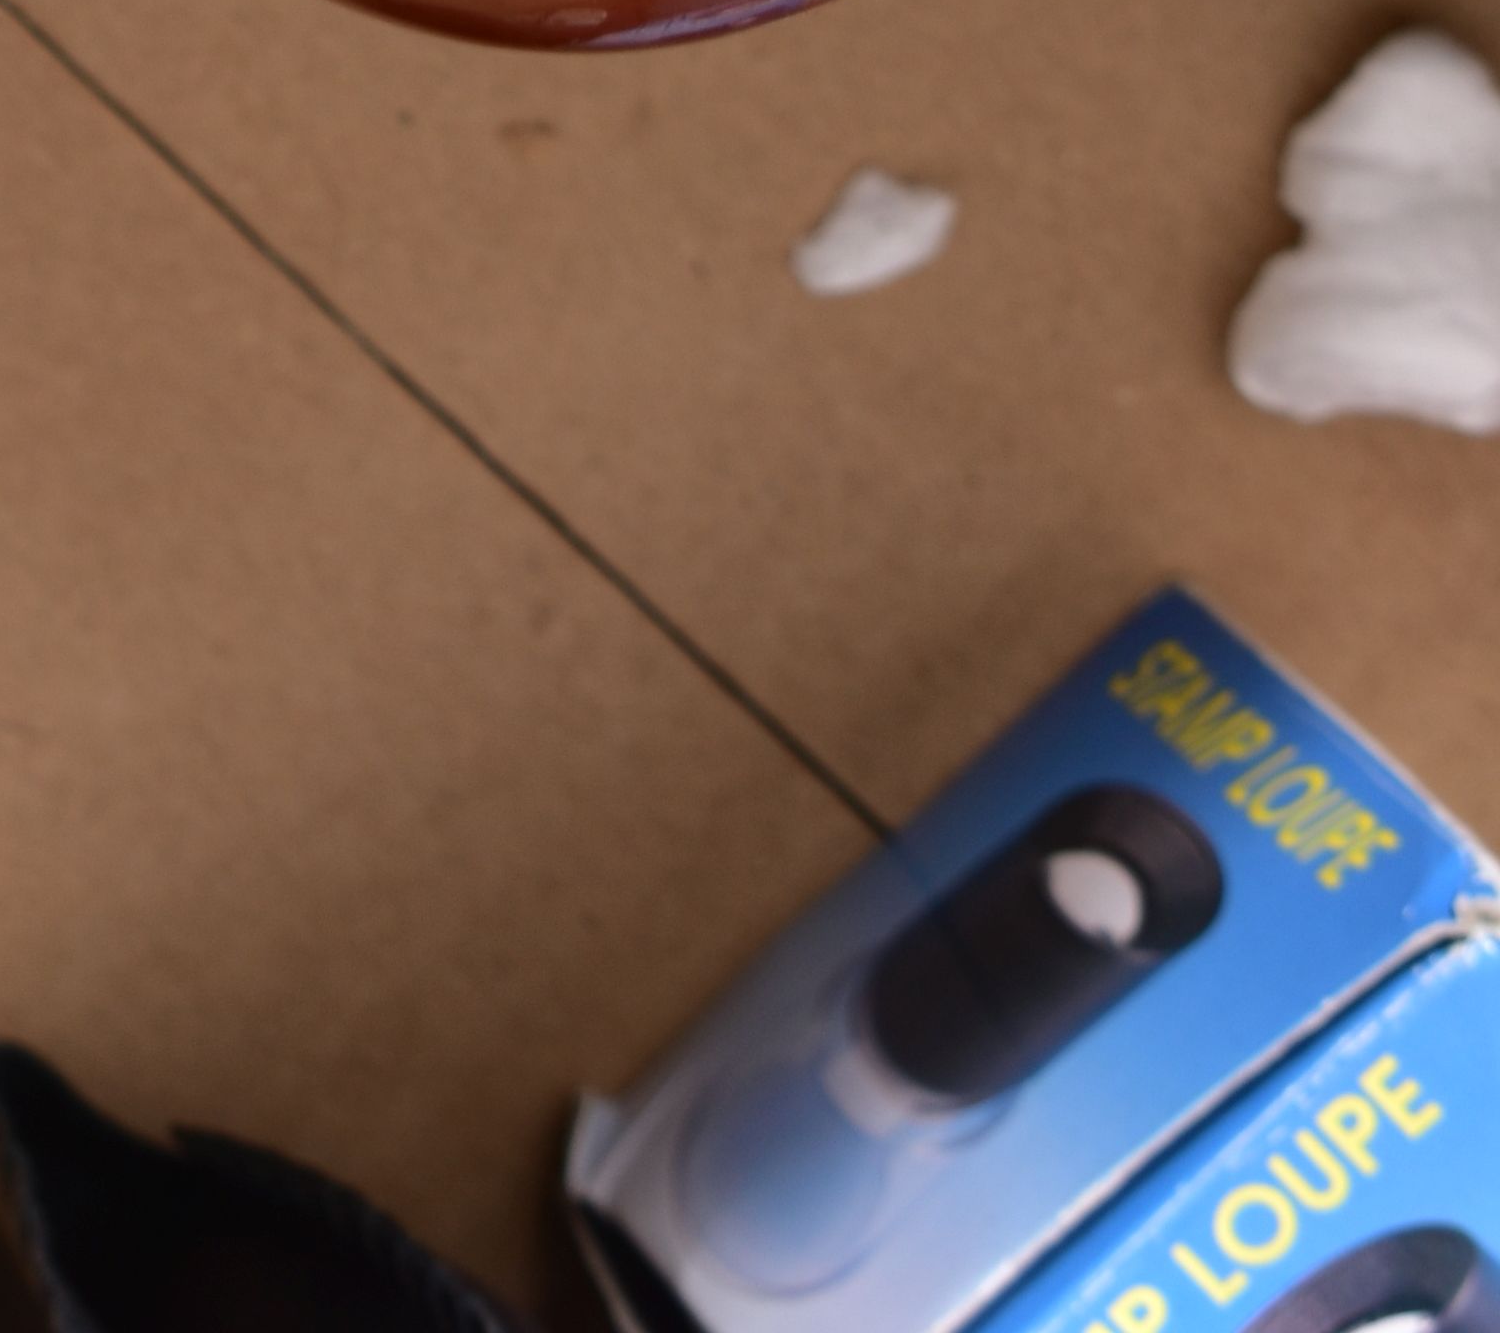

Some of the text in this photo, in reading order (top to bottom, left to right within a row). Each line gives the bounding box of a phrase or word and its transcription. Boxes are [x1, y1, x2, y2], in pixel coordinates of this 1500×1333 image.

[1110, 639, 1402, 890] STAMP LOUPE
[1171, 1054, 1444, 1308] LOUPE
